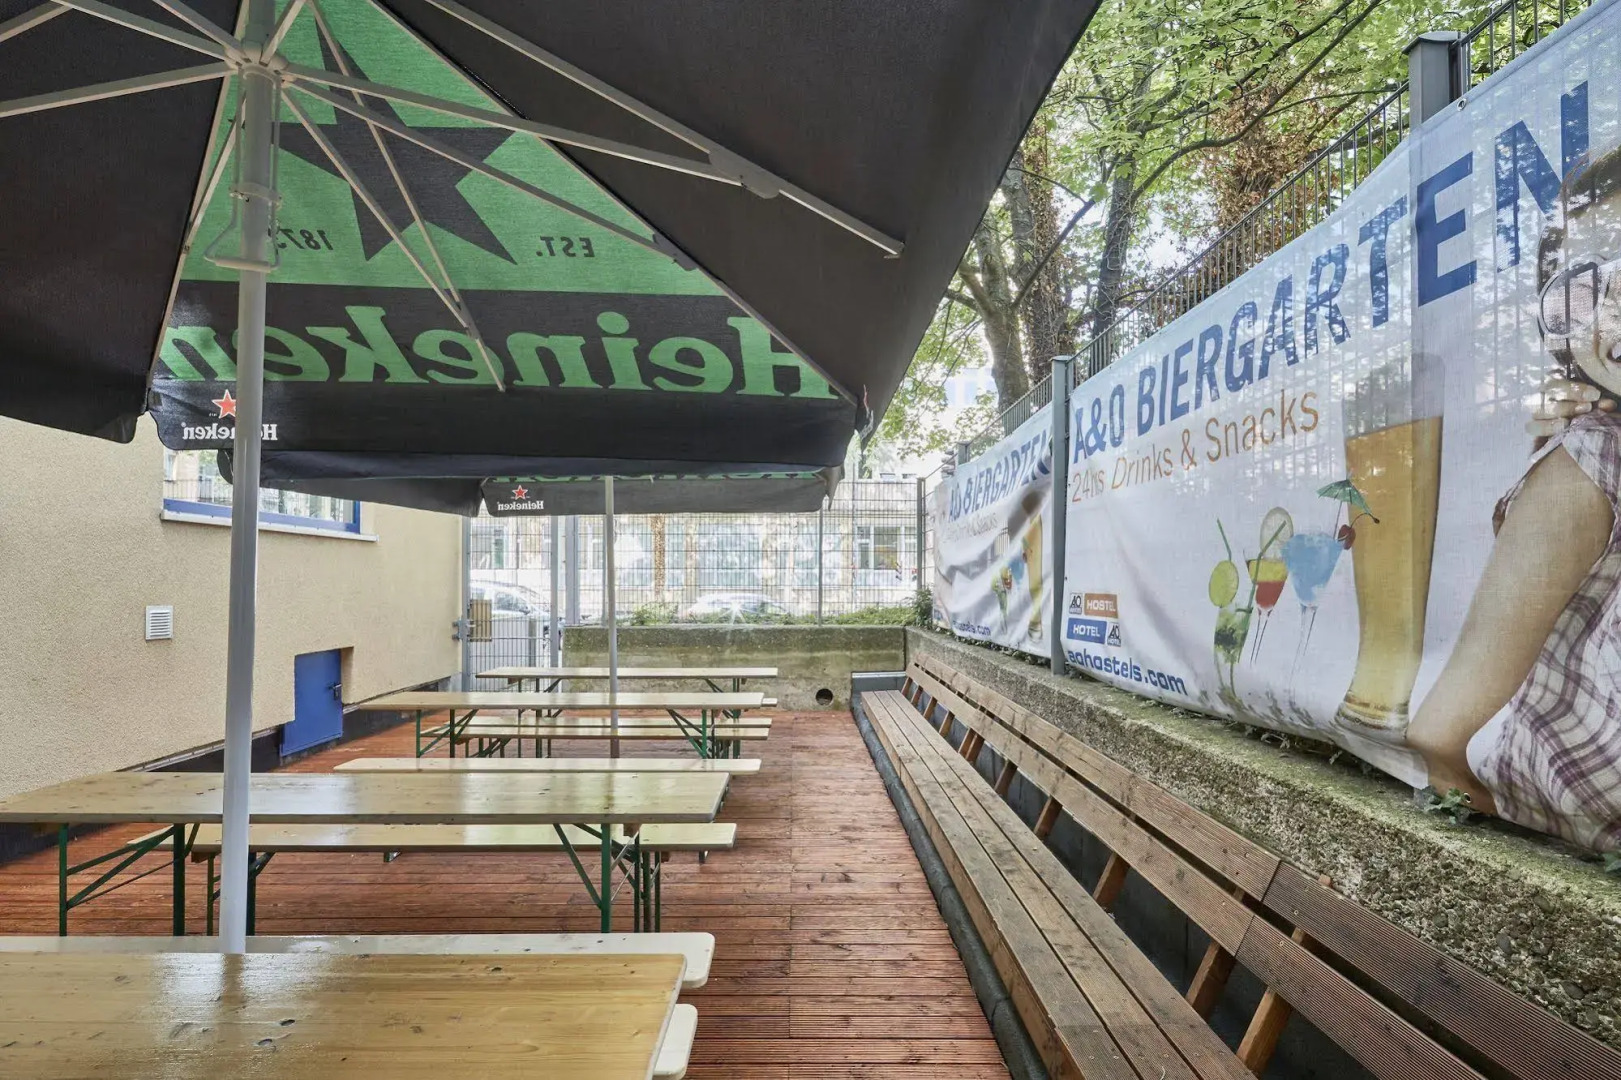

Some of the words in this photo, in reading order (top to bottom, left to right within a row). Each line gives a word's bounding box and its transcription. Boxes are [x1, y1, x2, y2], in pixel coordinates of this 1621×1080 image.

[1073, 383, 1125, 464] A&O
[1136, 80, 1590, 437] BIERGARTEN
[1111, 444, 1173, 490] Drinks
[1180, 428, 1197, 471] &
[1205, 388, 1319, 462] Snacks
[1086, 599, 1116, 612] HOSTEL
[1072, 624, 1101, 637] HOTEL
[1067, 648, 1188, 696] aohostels.com
